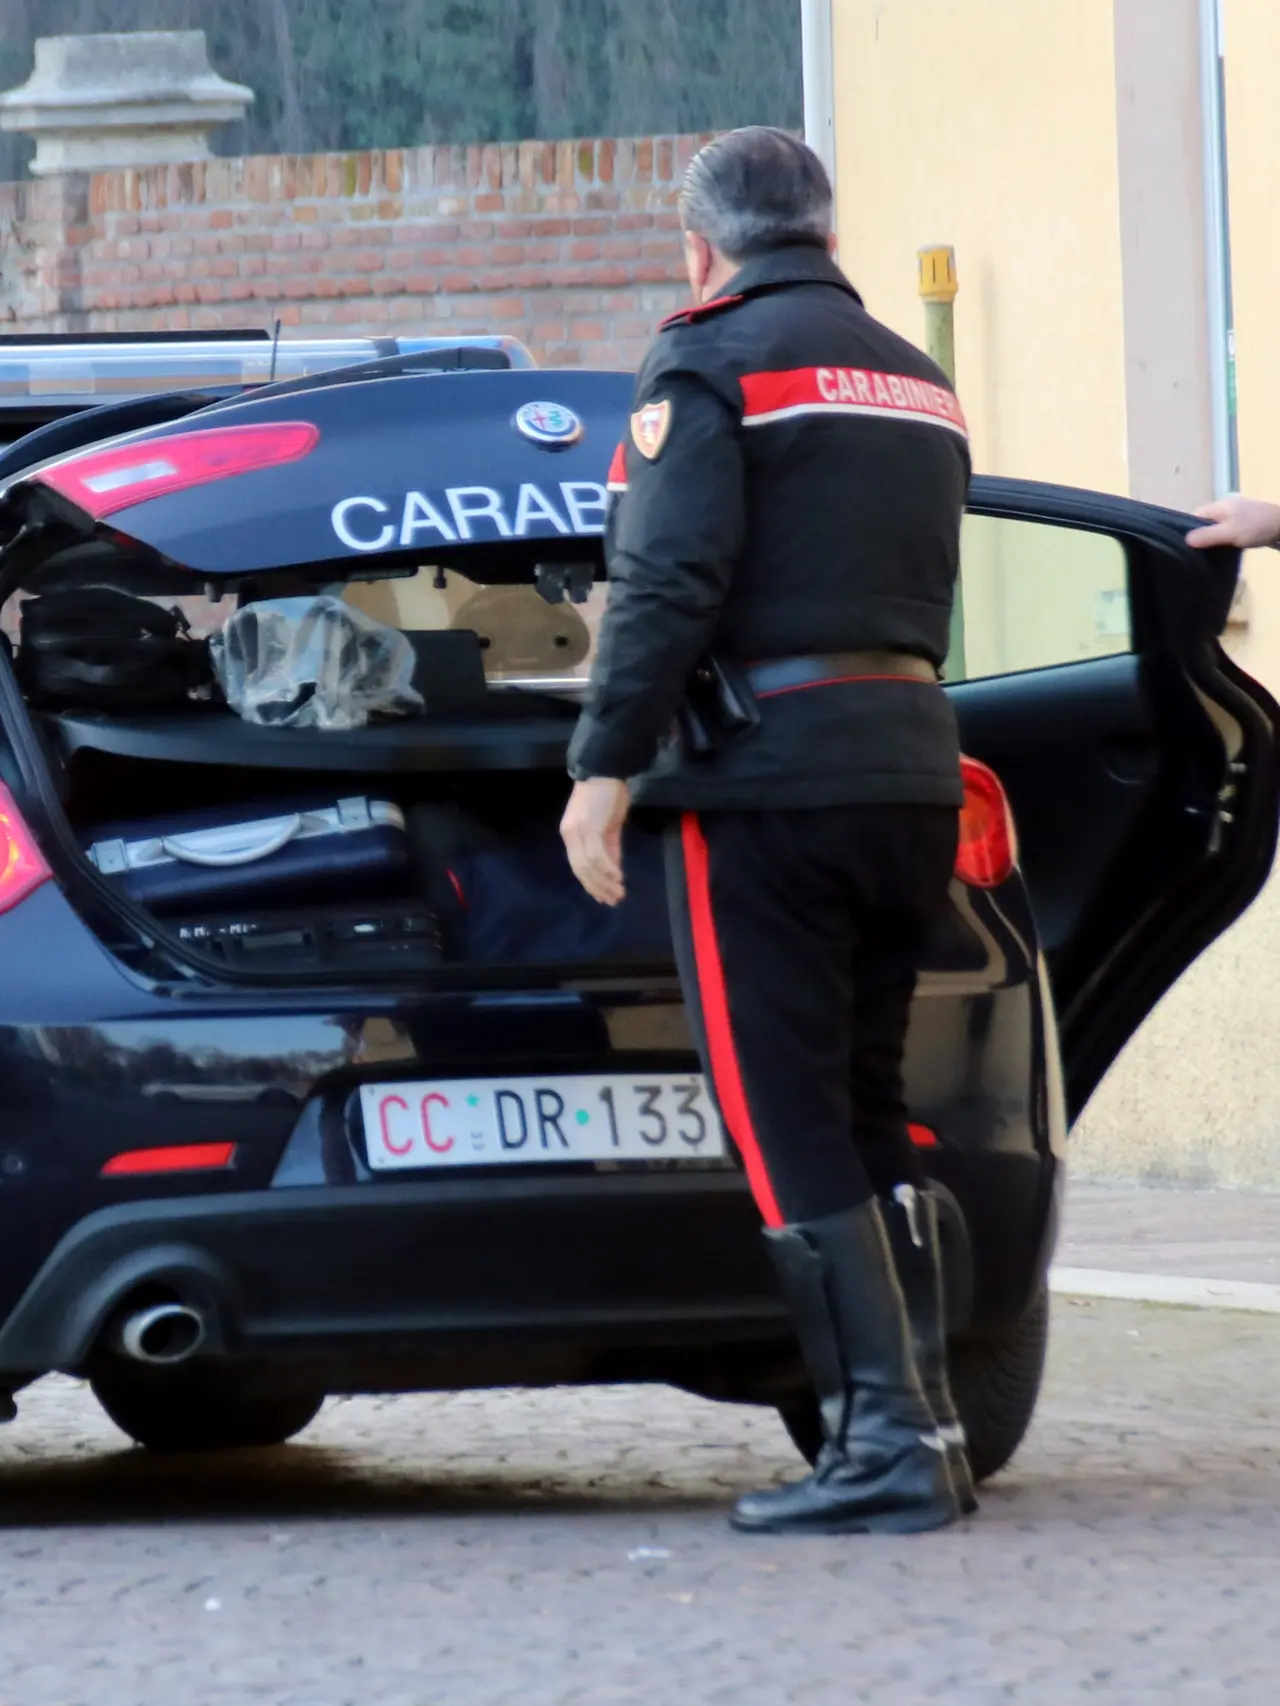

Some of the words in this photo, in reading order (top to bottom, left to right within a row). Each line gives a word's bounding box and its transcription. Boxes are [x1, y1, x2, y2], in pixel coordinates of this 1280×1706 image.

[331, 481, 608, 551] CARAB
[378, 1092, 455, 1157] CC
[493, 1087, 570, 1150] DR
[597, 1084, 707, 1147] 133
